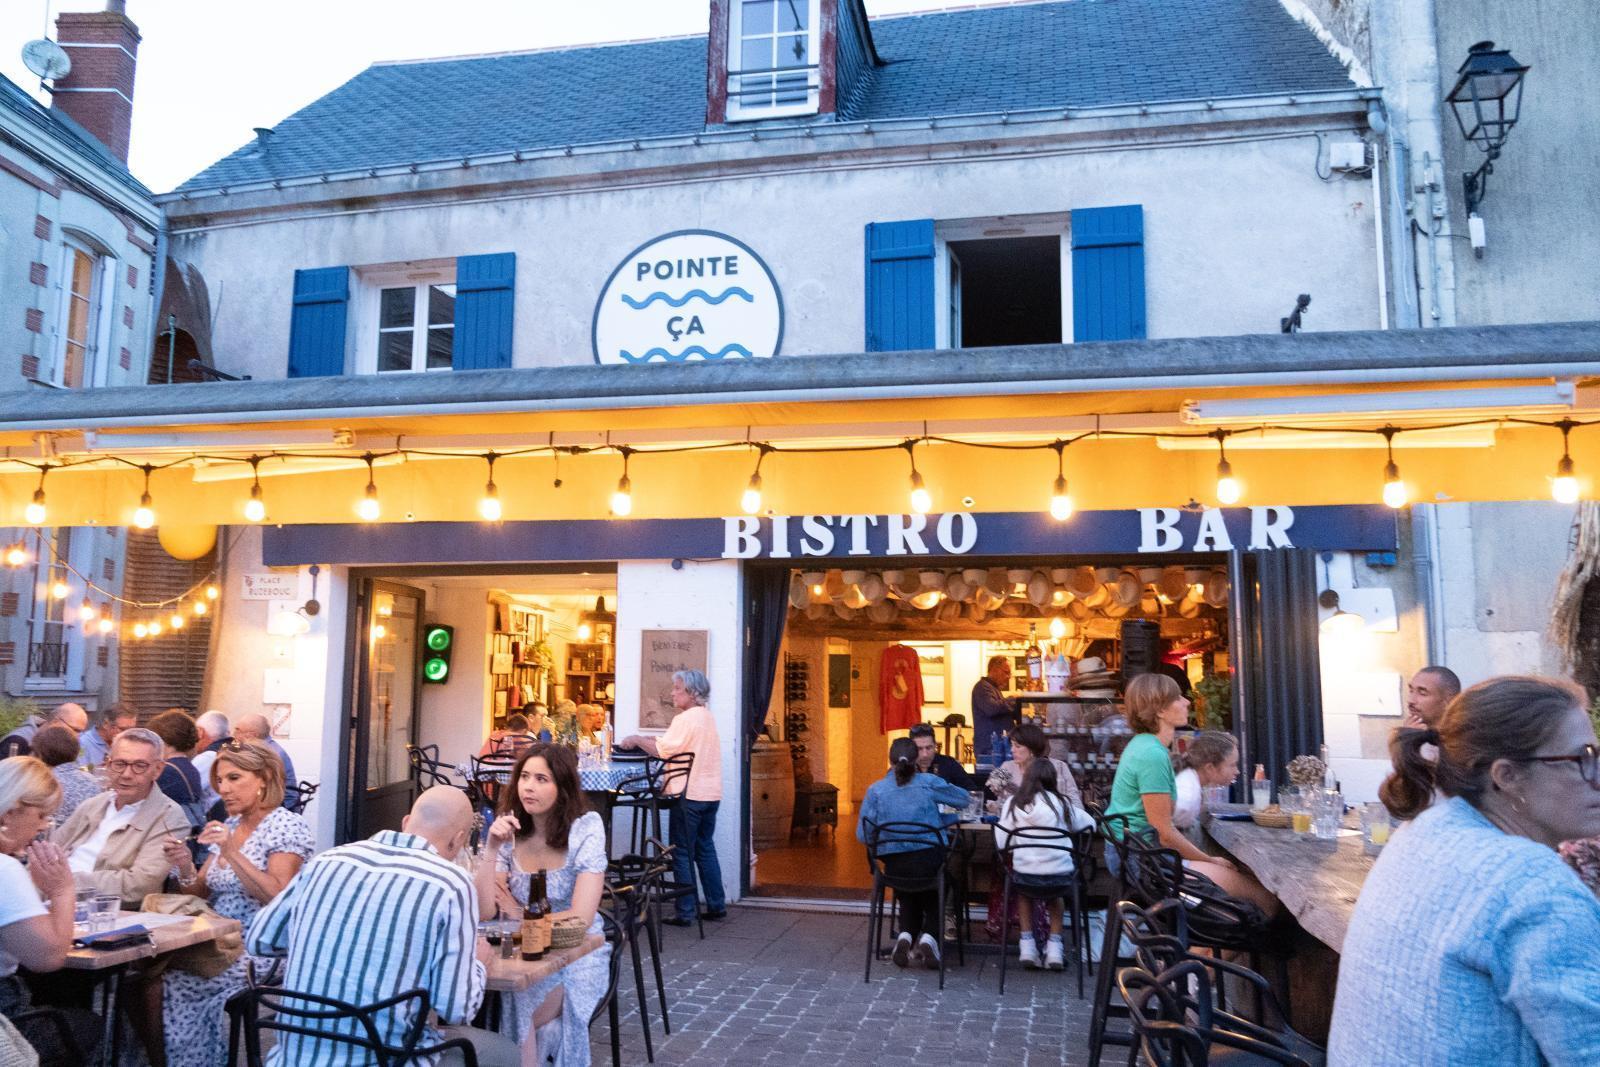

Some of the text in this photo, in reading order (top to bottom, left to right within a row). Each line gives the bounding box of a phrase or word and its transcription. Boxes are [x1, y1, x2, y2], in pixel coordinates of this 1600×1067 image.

[636, 255, 739, 281] POINTE
[666, 315, 705, 341] ÇA
[720, 505, 1297, 559] BISTRO BAR
